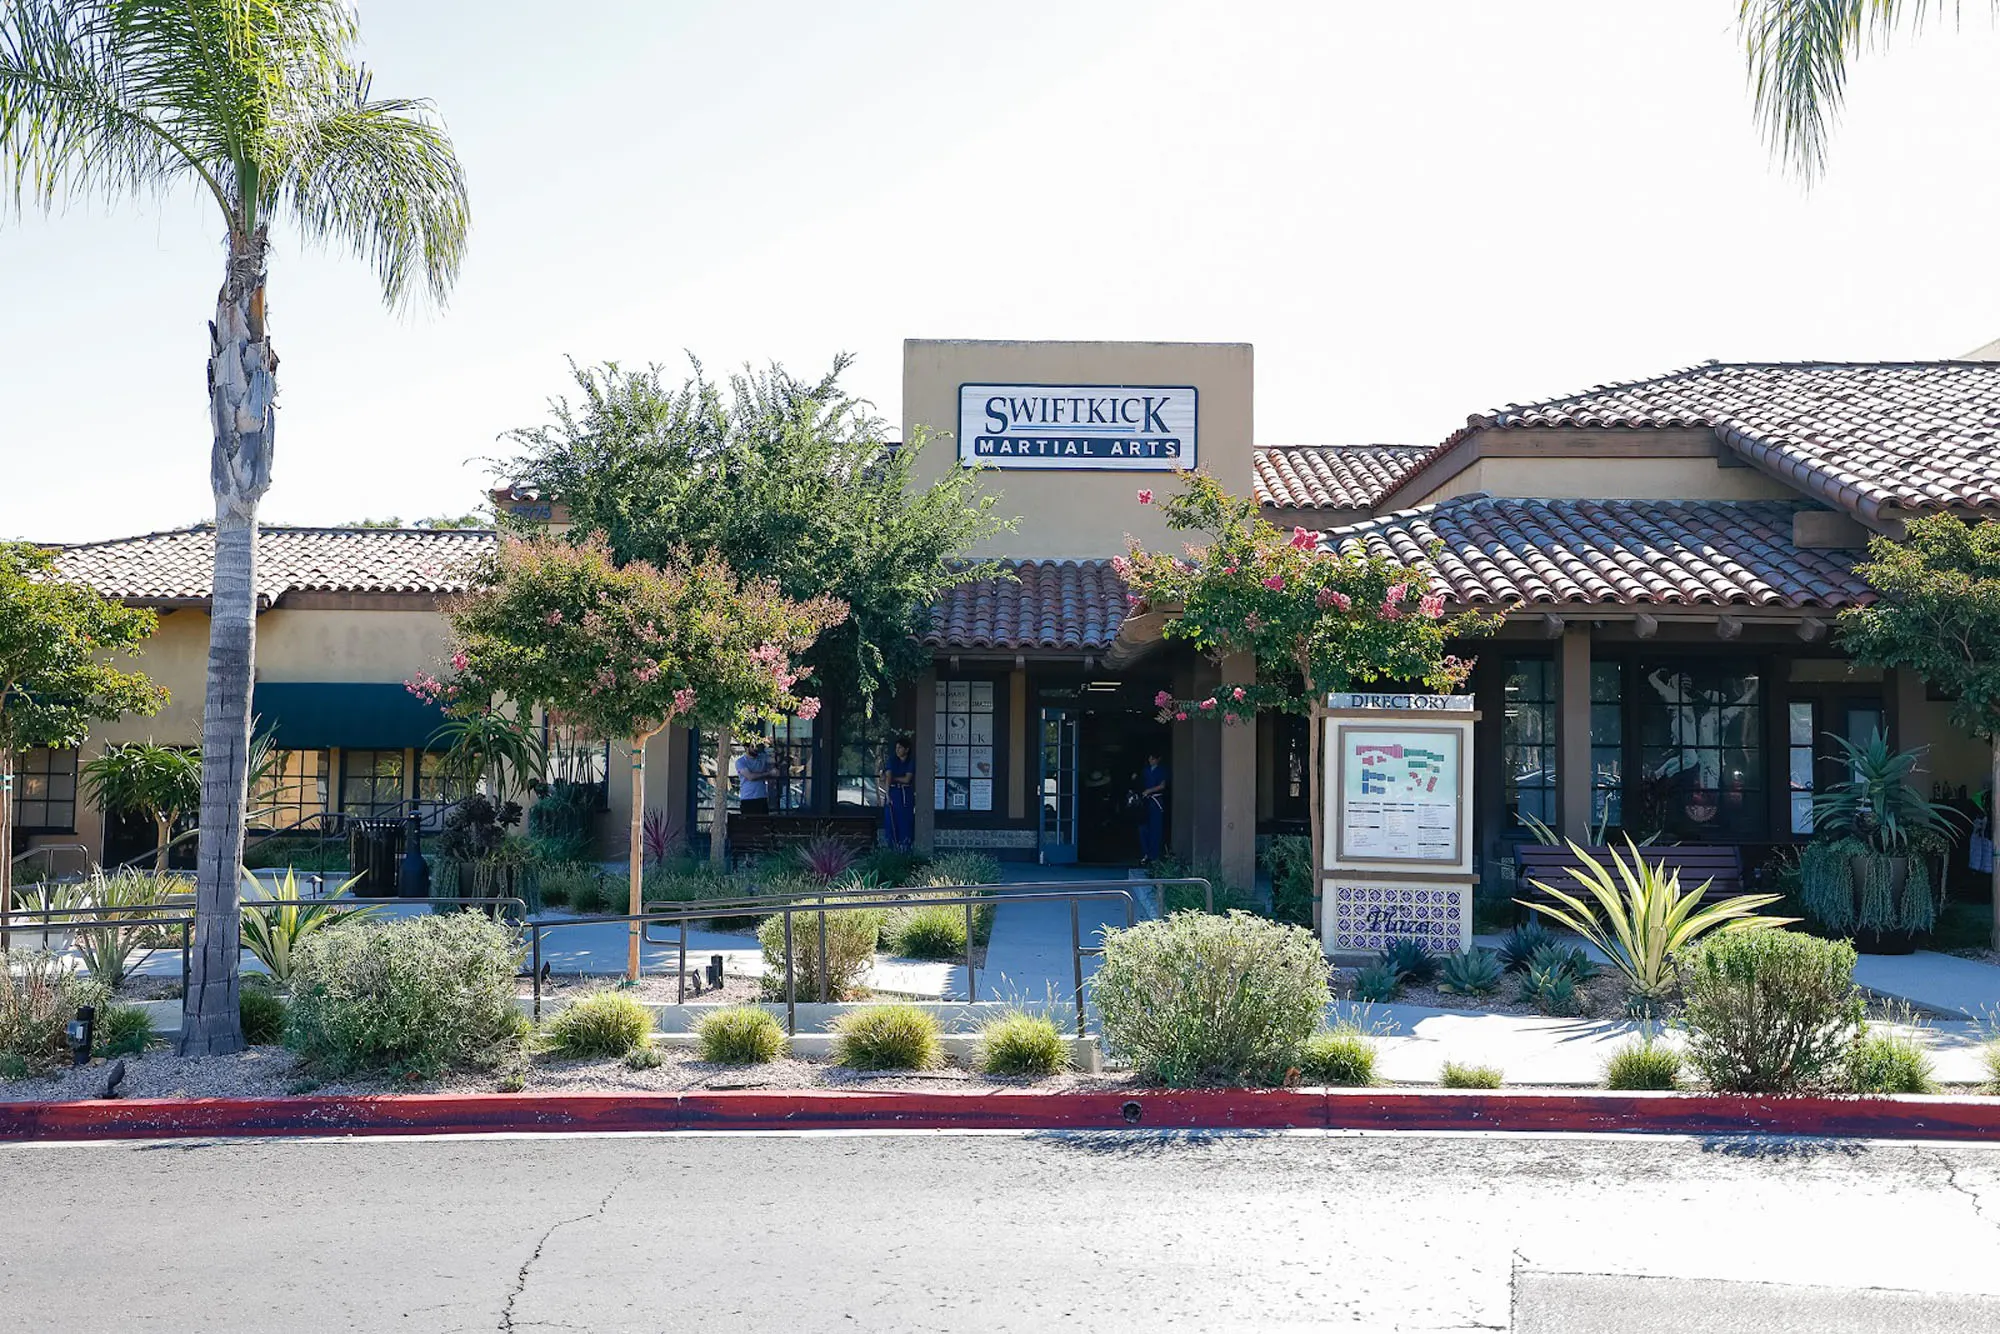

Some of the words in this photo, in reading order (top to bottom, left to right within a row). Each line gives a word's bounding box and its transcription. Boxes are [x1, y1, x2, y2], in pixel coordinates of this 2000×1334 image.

[985, 396, 1171, 434] SWIFTKICK
[979, 439, 1094, 455] MARTIAL
[1111, 441, 1176, 456] ARTS
[1847, 665, 1854, 674] 2
[1351, 694, 1450, 709] DIRECTORY
[1366, 905, 1431, 933] Plaza
